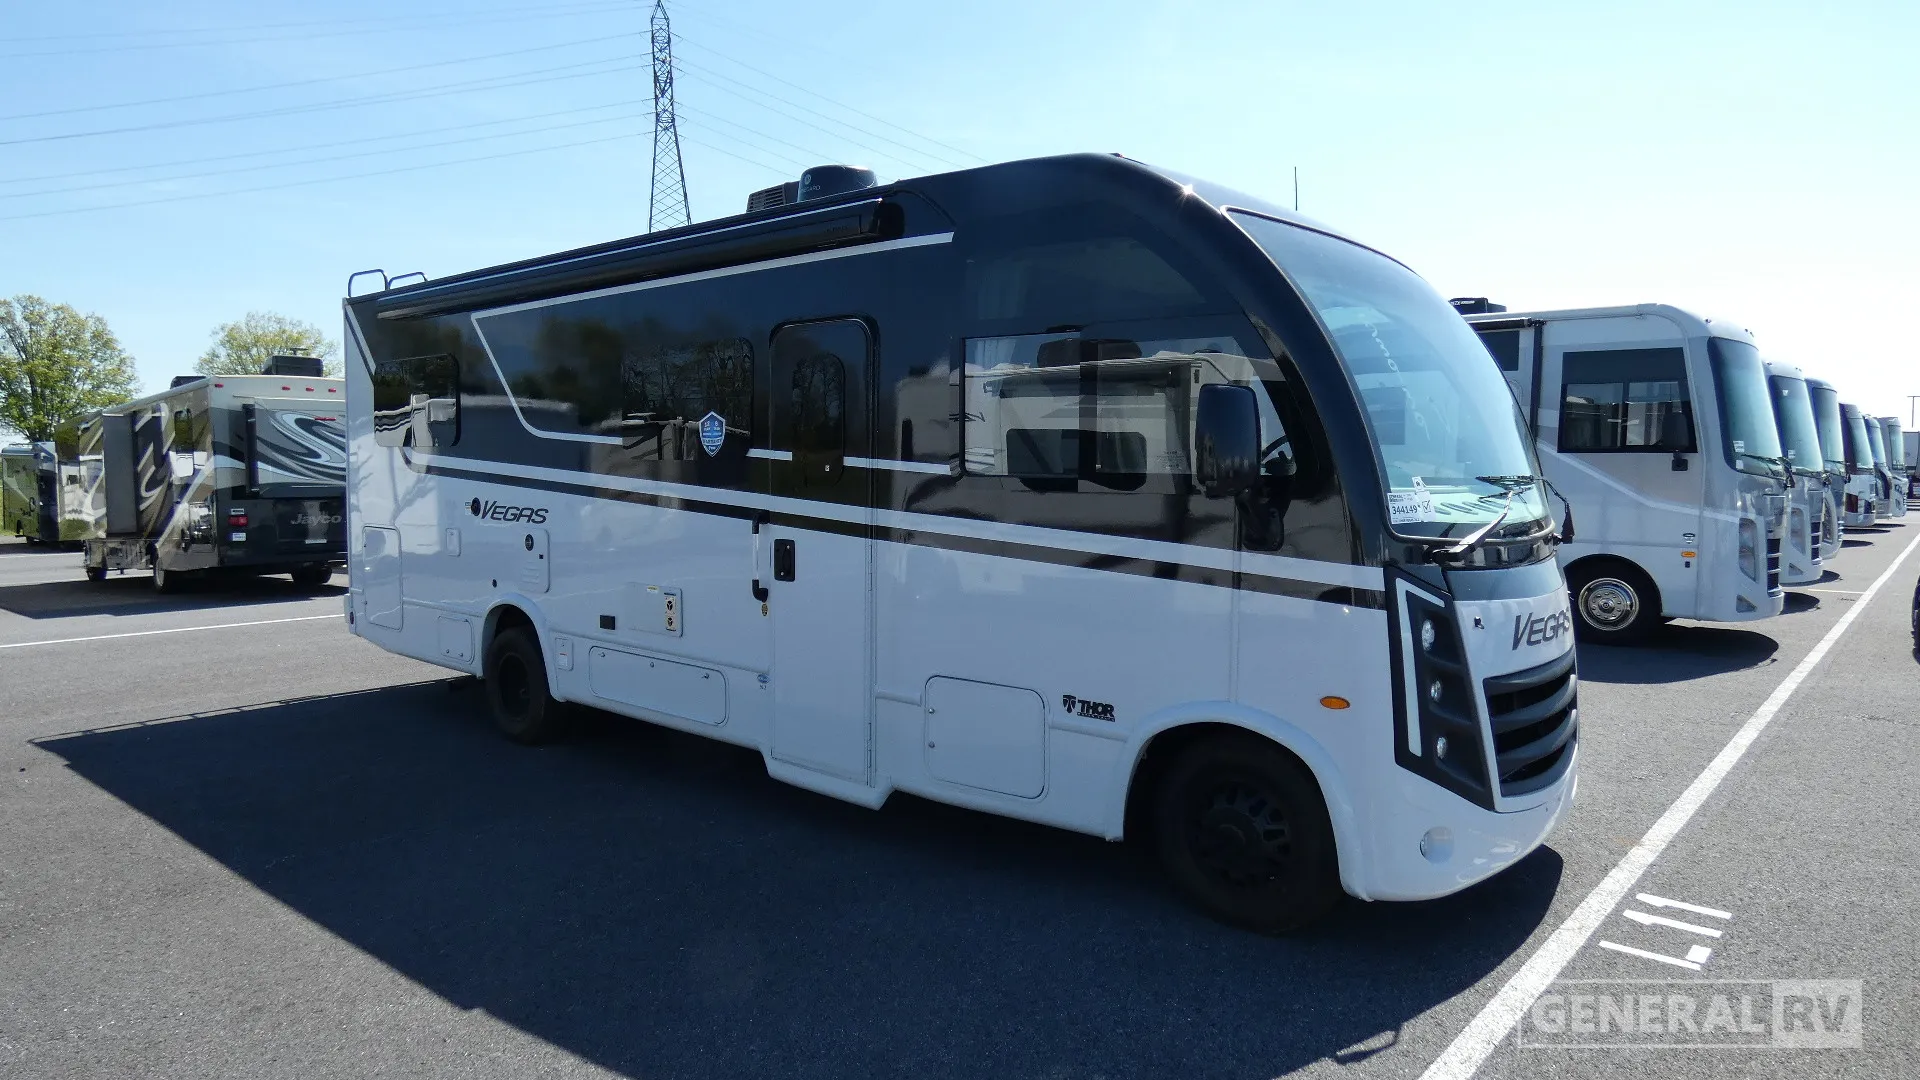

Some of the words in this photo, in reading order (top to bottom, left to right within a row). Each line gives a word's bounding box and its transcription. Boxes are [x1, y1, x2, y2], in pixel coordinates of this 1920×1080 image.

[291, 513, 342, 526] Jayco
[481, 500, 549, 524] VEGAS
[1392, 505, 1418, 515] 344149
[1512, 606, 1570, 651] VEGAS
[1077, 699, 1115, 718] THOR
